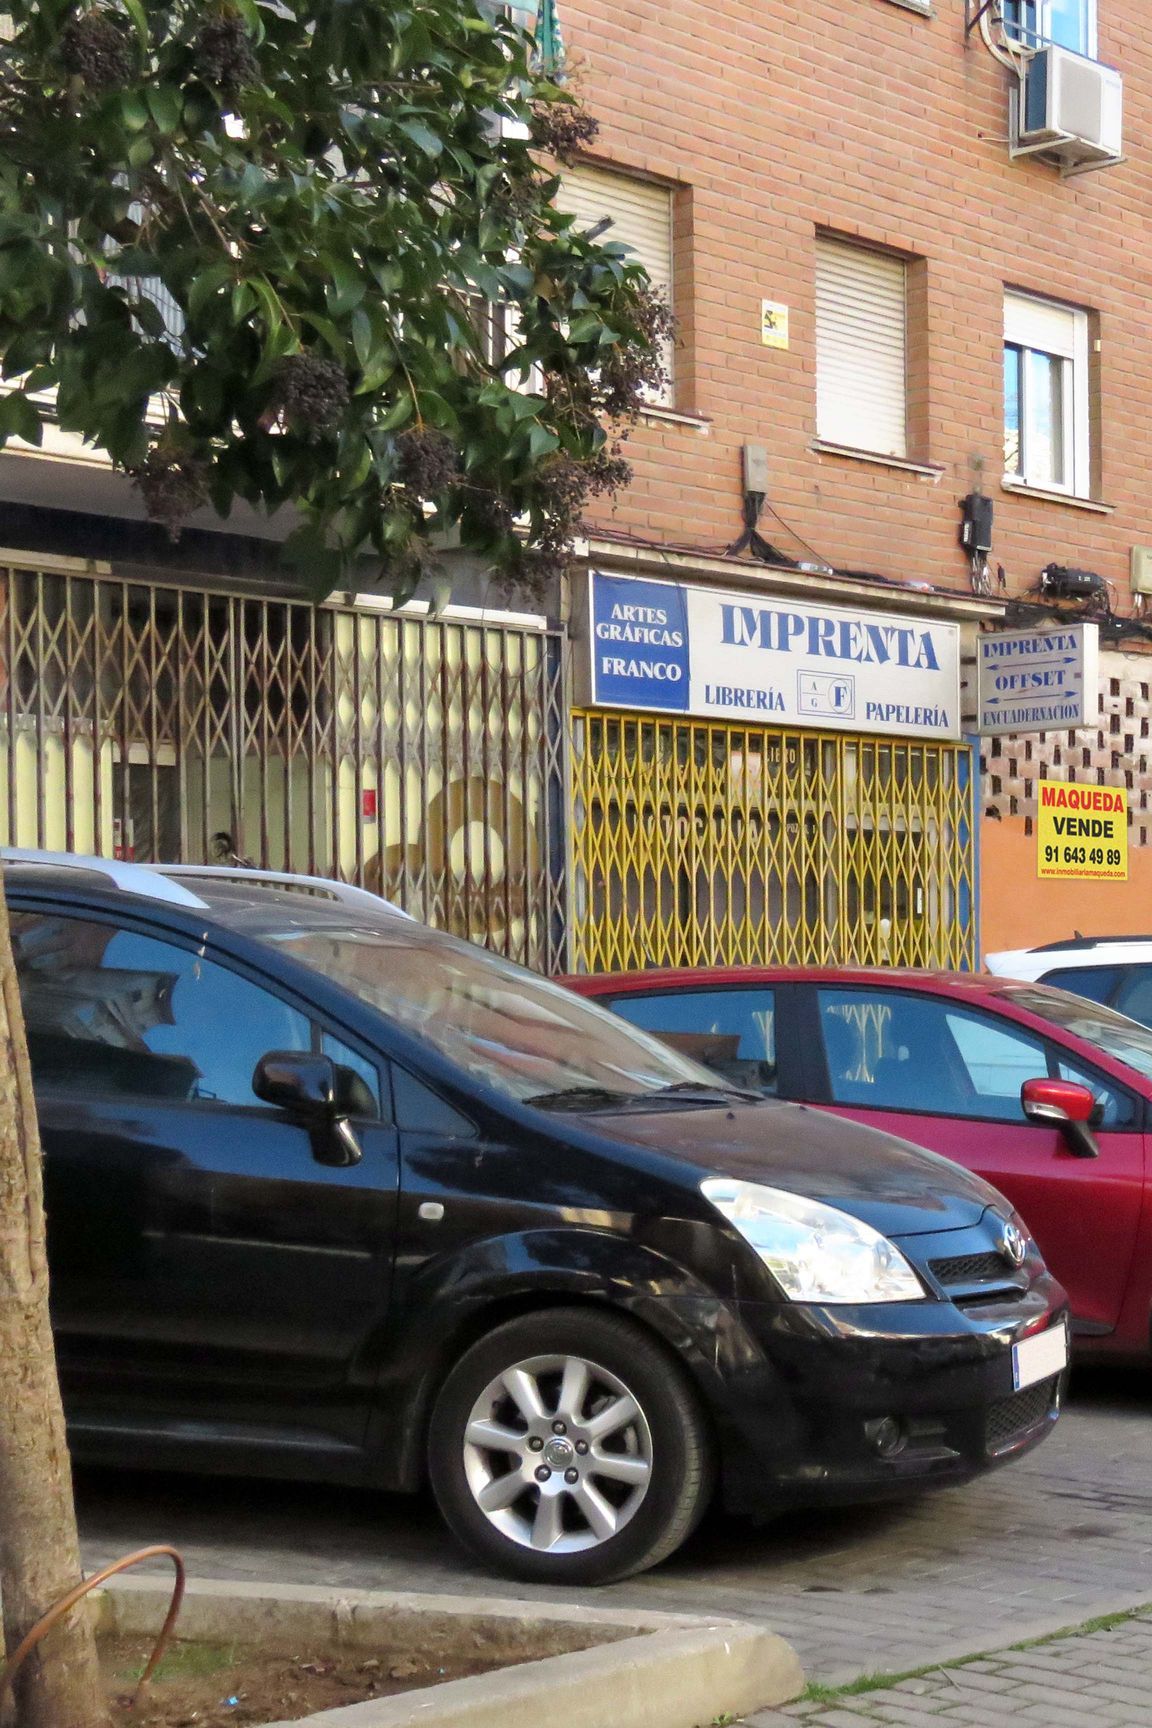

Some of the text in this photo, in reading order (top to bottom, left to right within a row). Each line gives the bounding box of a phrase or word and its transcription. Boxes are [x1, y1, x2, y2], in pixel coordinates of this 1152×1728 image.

[611, 603, 667, 625] ARTES
[596, 623, 683, 648] GRÁFICAS
[719, 603, 941, 671] IMPRENTA
[983, 634, 1078, 658] IMPRENTA
[602, 656, 682, 682] FRANCO
[995, 670, 1066, 690] OFFSET
[705, 684, 785, 712] LIBRERÍA
[811, 682, 818, 691] A
[834, 686, 848, 707] F
[811, 698, 818, 708] G
[865, 701, 949, 728] PAPELERÍA
[983, 704, 1080, 726] ENCUADERNACION
[1042, 786, 1124, 813] MAQUEDA
[1053, 816, 1114, 839] VENDE
[1045, 845, 1121, 865] 91 643 49 89
